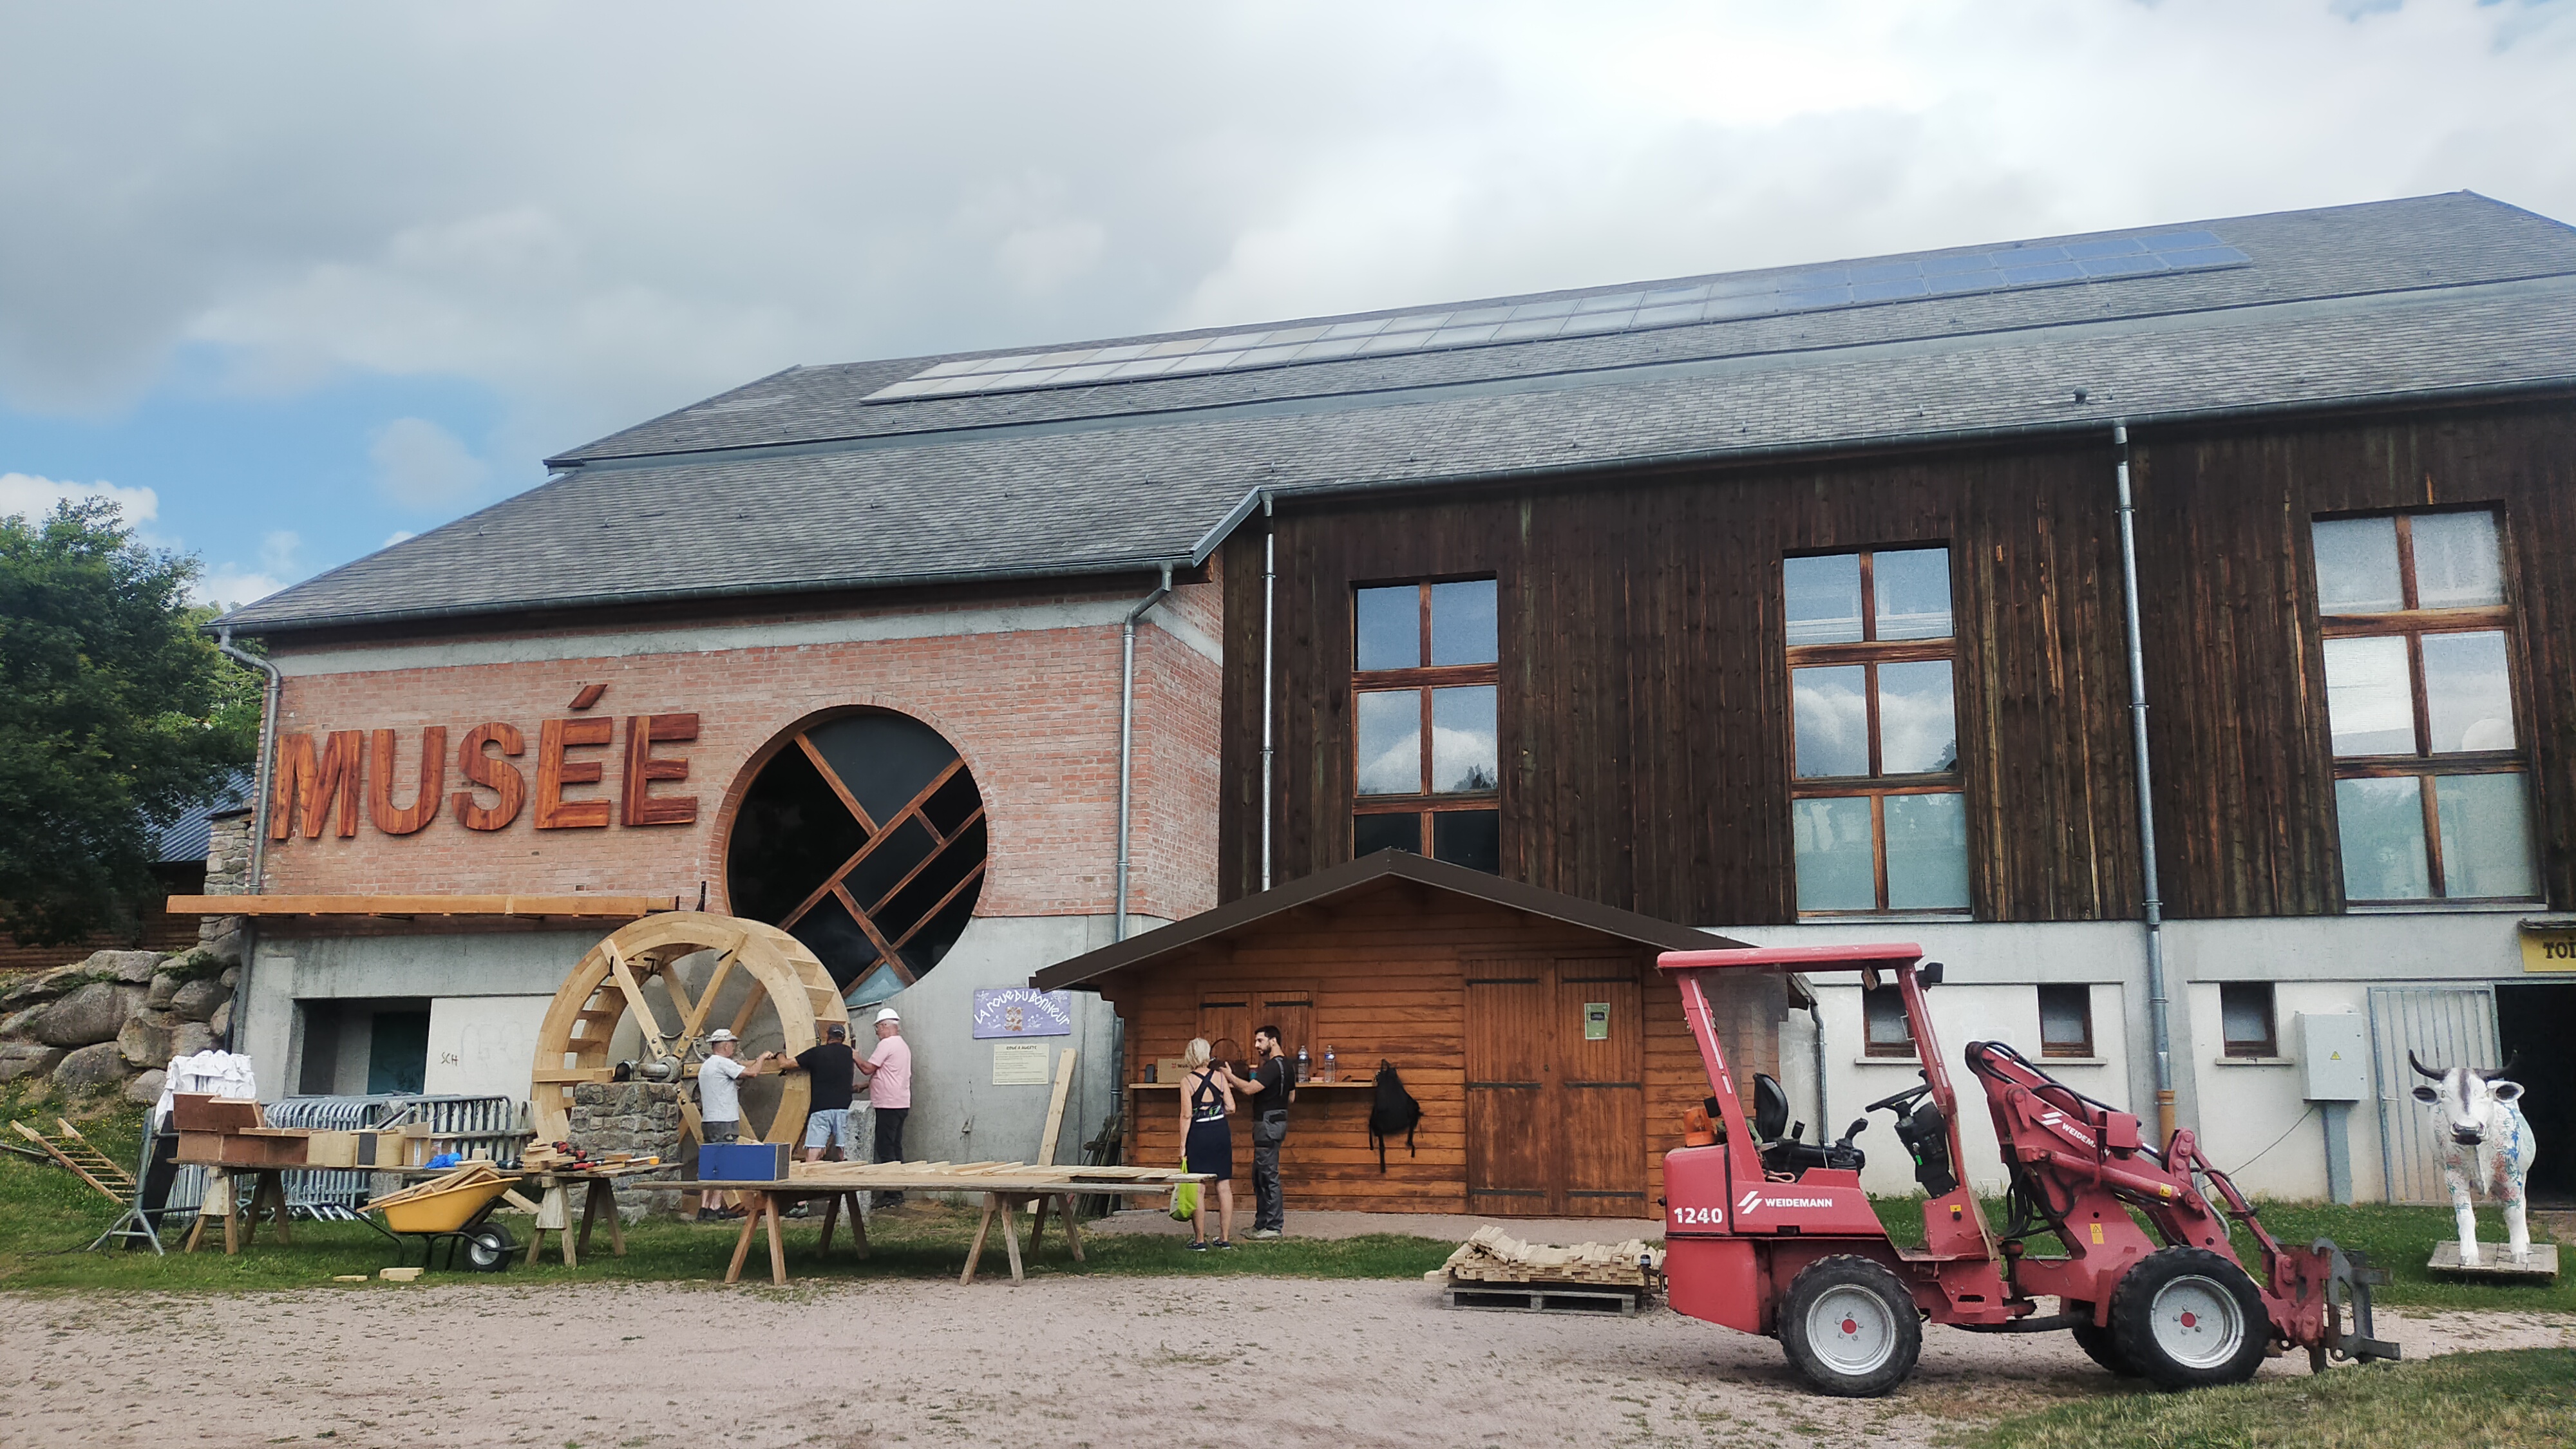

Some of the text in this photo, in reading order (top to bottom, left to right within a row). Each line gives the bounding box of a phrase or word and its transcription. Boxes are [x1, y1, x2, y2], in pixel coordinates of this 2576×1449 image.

[269, 683, 699, 839] MUSÉE
[974, 1009, 991, 1024] LA
[1014, 990, 1028, 1002] DU
[2062, 1122, 2111, 1157] WEIDEMN
[1674, 1208, 1723, 1224] 1240
[1765, 1198, 1833, 1208] WEIDEMANN
